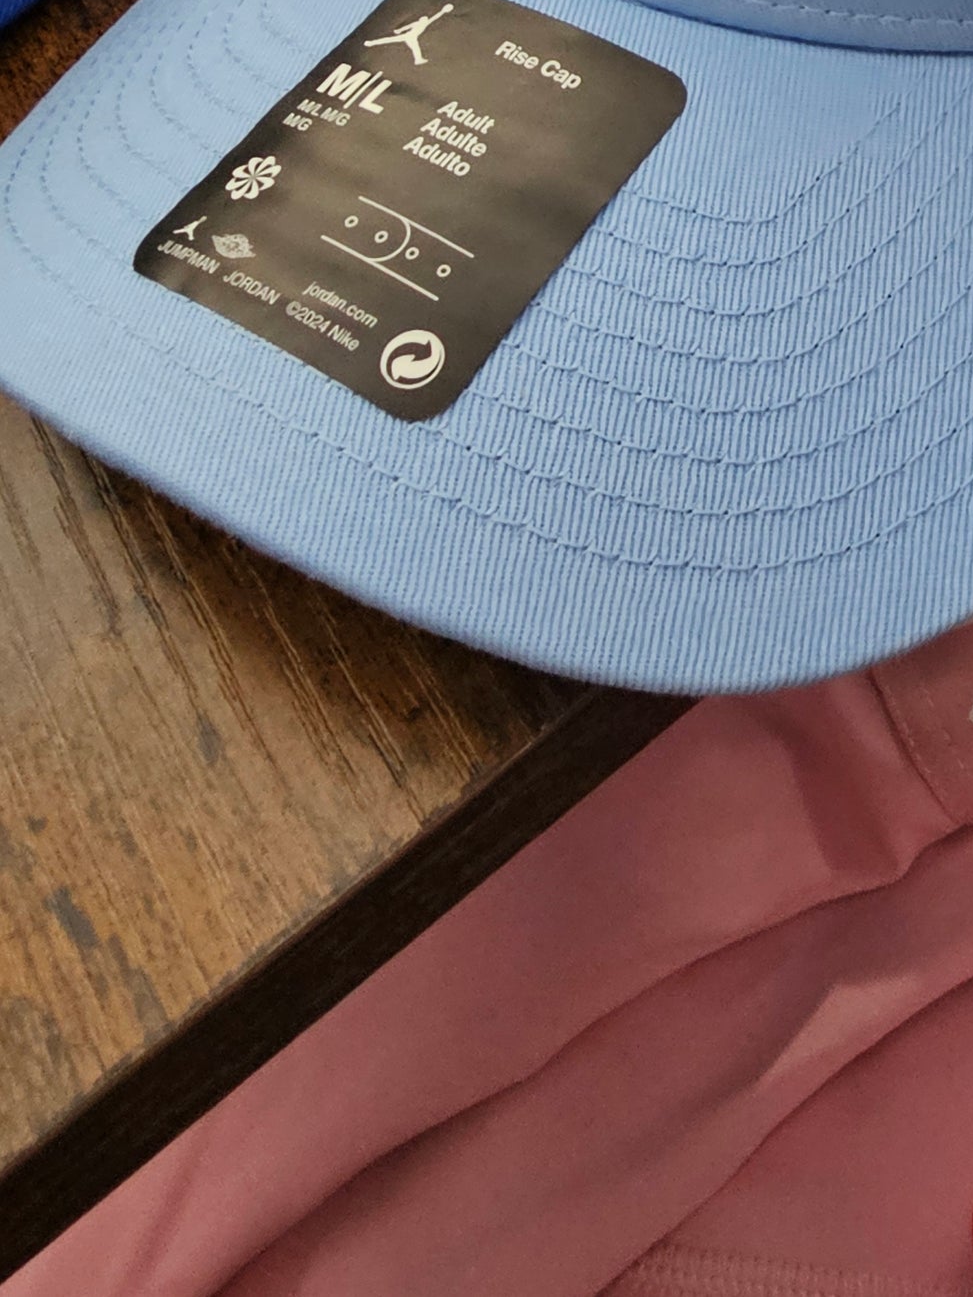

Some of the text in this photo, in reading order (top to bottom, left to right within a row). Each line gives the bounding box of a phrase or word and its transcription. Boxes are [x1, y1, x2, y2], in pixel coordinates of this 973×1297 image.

[495, 40, 582, 90] Rise Cap
[316, 63, 392, 114] M/L
[420, 117, 488, 158] Adulte
[436, 101, 496, 135] Adult
[402, 136, 471, 177] Adulto
[157, 239, 281, 306] JUMPMAN JORDAN
[302, 281, 378, 329] jordan.com
[327, 324, 360, 352] Nike
